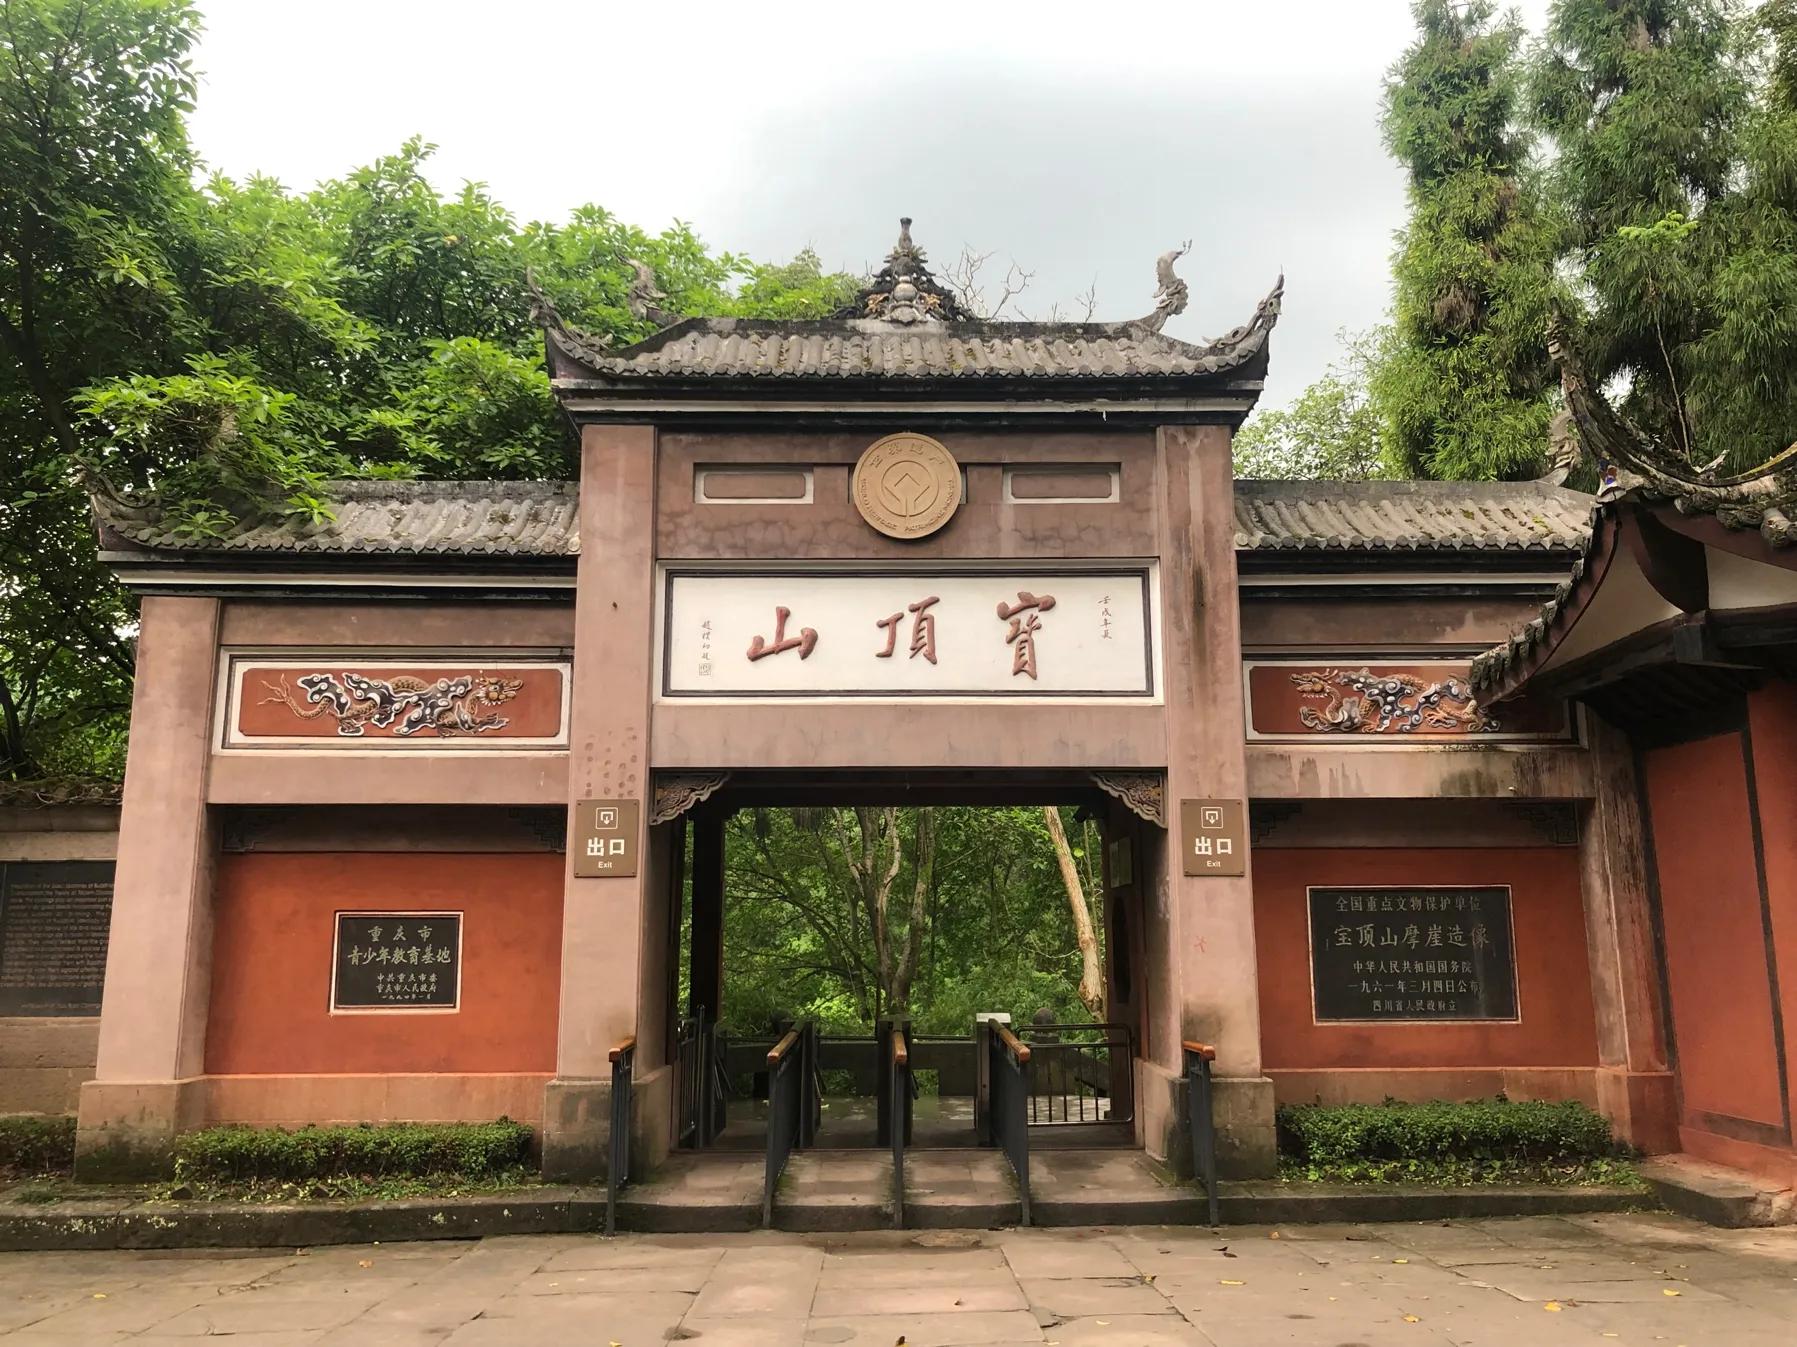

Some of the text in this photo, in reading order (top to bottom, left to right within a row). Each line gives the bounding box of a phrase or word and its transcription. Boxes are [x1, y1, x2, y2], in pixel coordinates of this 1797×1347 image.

[587, 837, 625, 856] 出口
[1195, 836, 1232, 855] 出口
[1336, 896, 1481, 912] 全国重点文物保护单位
[368, 925, 432, 942] 重庆市
[1334, 923, 1490, 949] 宝顶山摩崖造像
[347, 944, 451, 965] 青少年教育基地
[1353, 960, 1472, 974] 中华人民共和国国务院
[376, 983, 437, 993] 重庆市人民政府
[1348, 979, 1480, 994] 一九六一年三月四日公布
[1373, 1000, 1457, 1012] 四川省人民政府立
